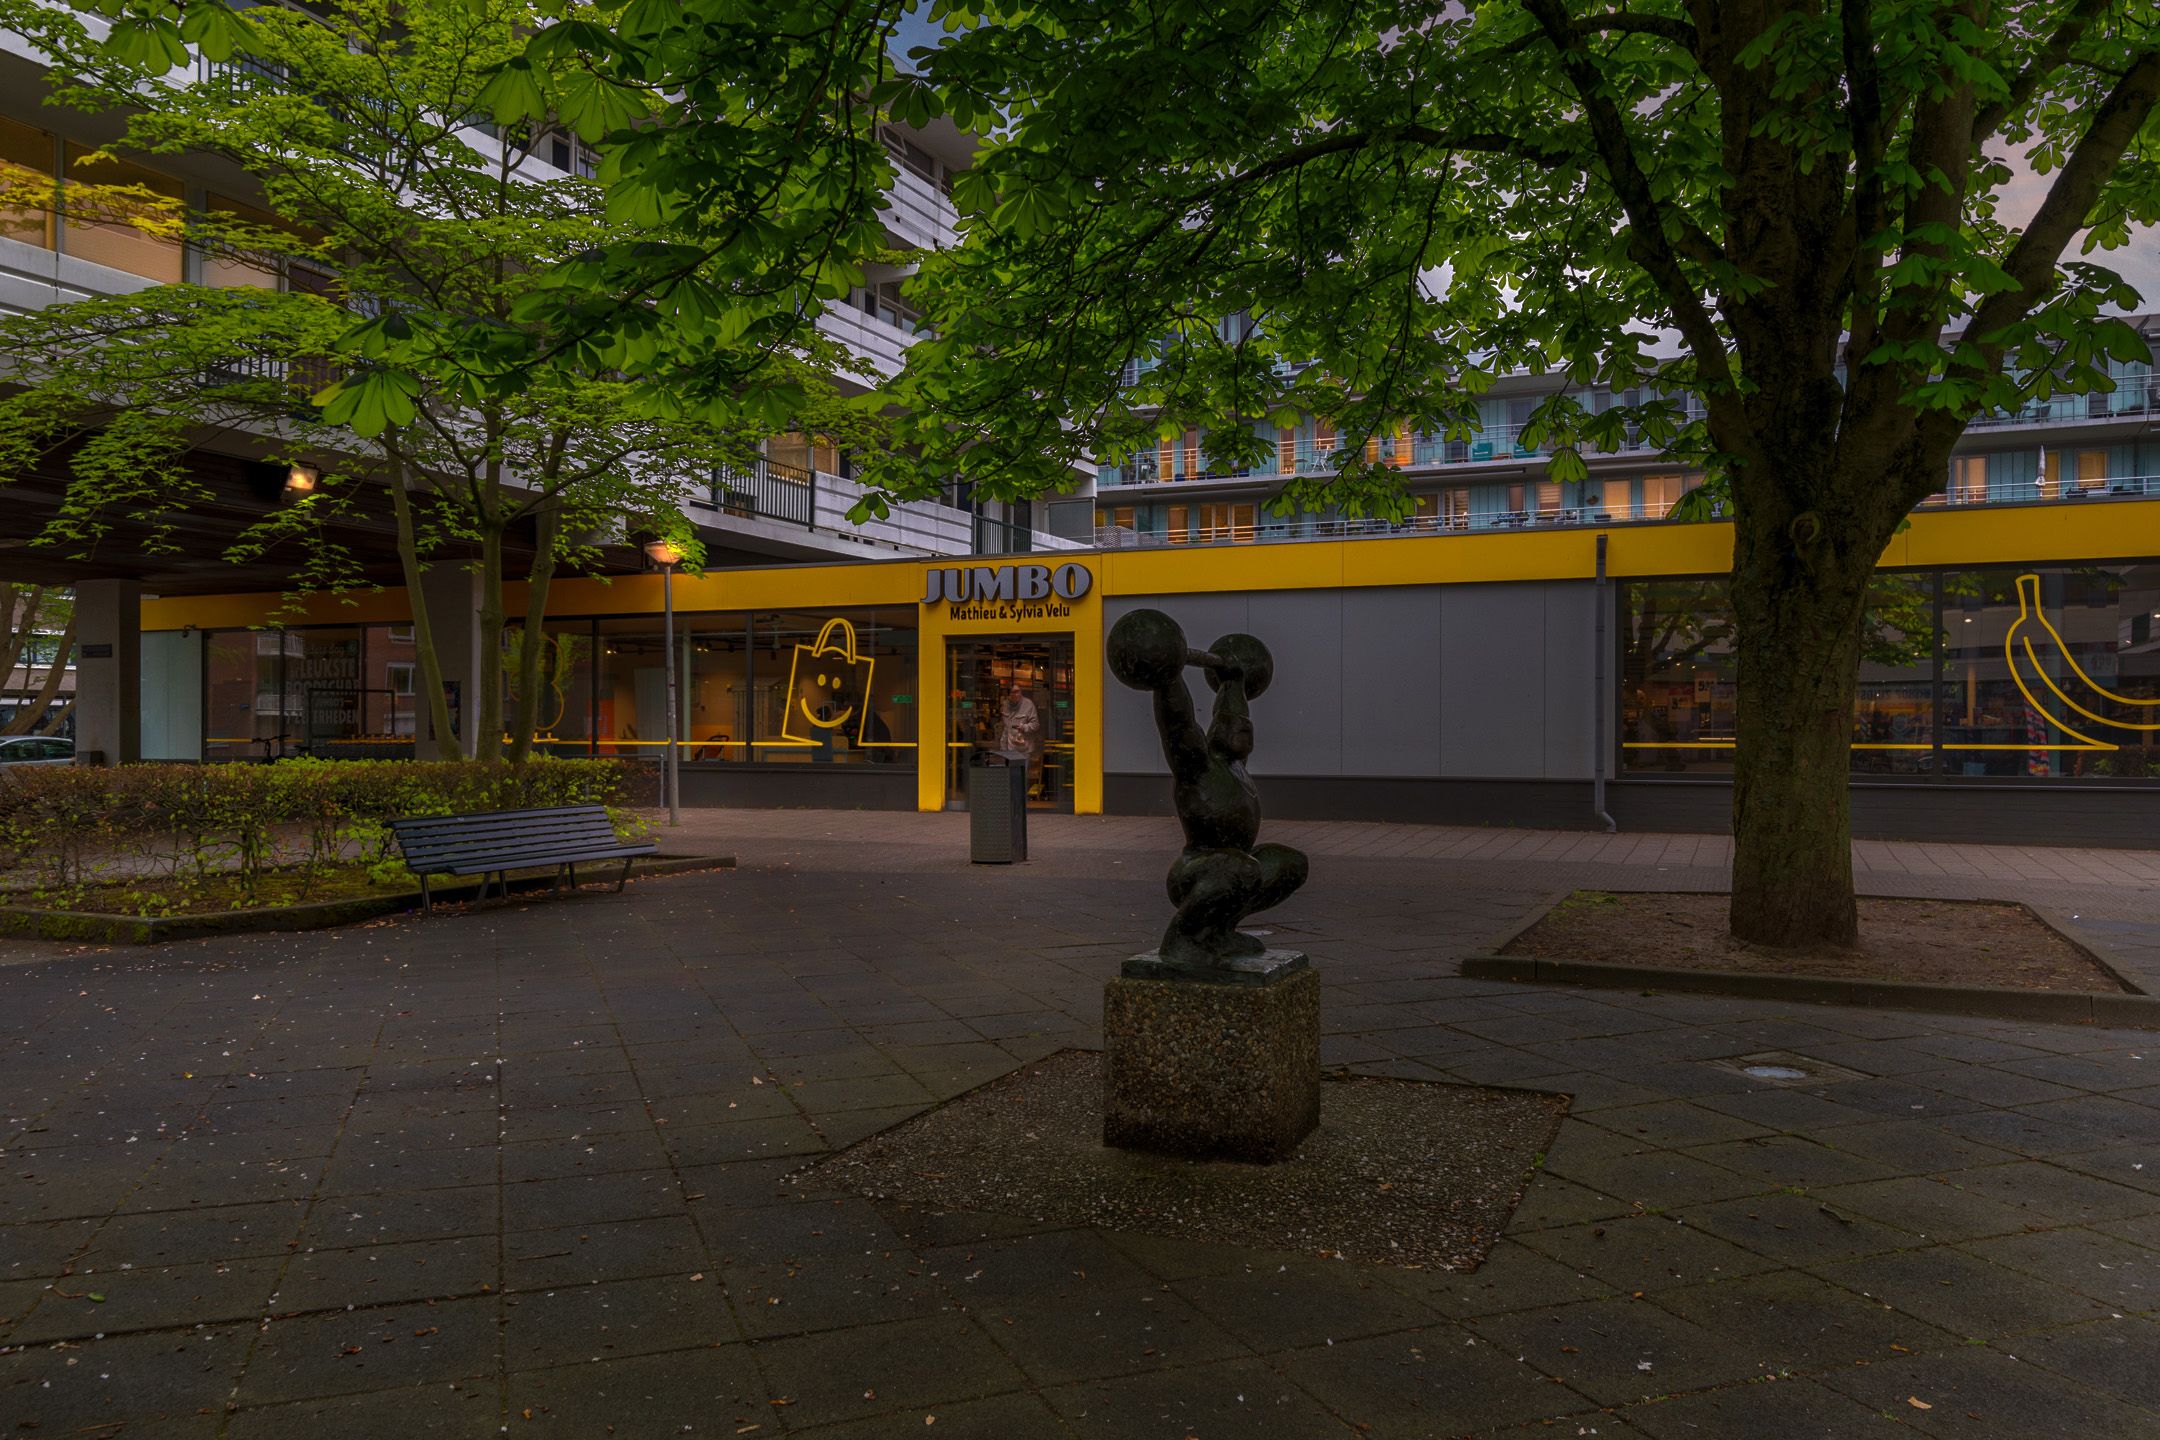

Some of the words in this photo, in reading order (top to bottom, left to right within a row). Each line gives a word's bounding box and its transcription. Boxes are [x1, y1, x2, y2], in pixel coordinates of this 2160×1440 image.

[920, 563, 1092, 604] JUMBO
[950, 606, 996, 620] Mathieu
[999, 606, 1007, 619] &
[1010, 605, 1043, 622] Sylvia
[1046, 603, 1070, 617] Velu
[301, 657, 355, 679] LEUKSTE
